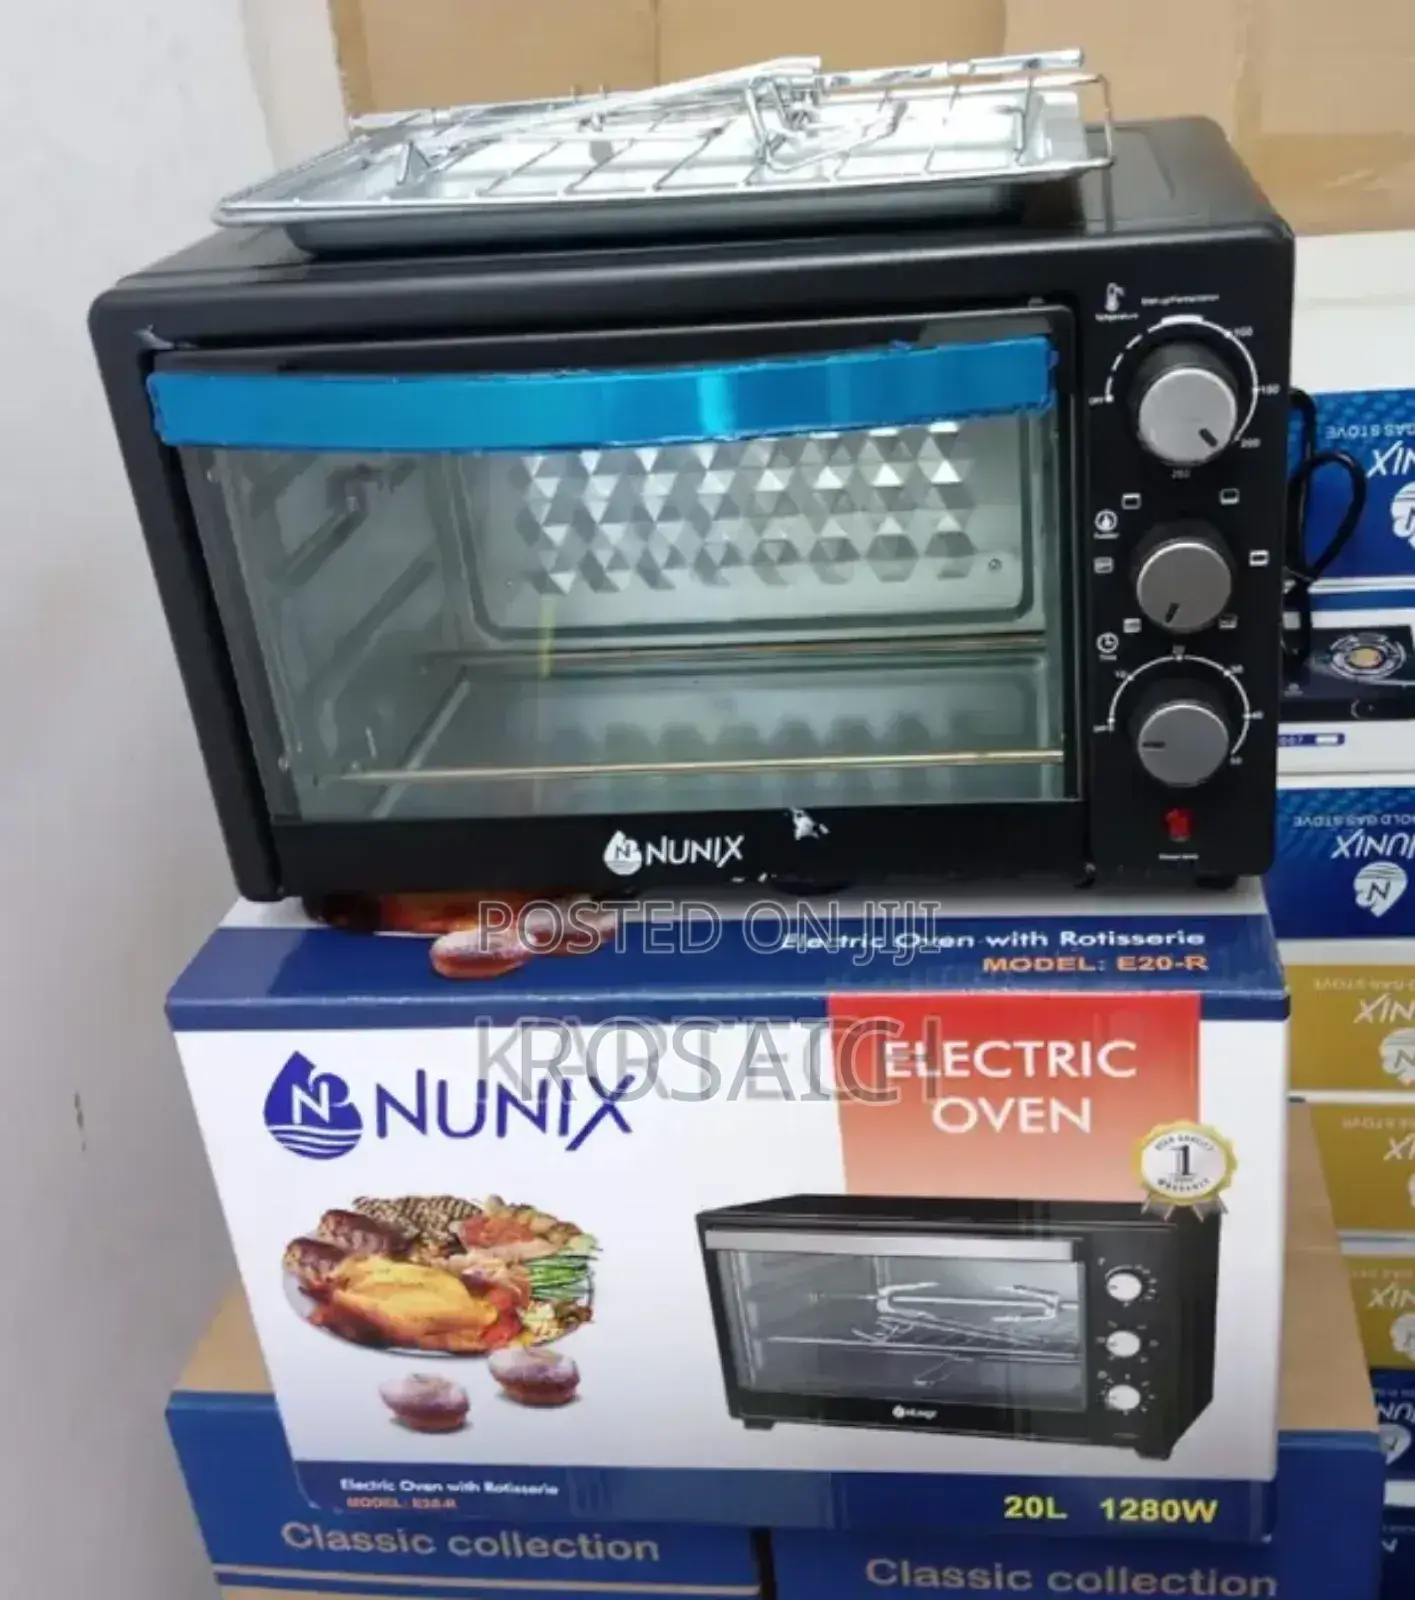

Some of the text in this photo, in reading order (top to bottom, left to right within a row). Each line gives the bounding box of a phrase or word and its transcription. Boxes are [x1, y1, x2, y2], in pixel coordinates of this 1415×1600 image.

[1325, 424, 1381, 440] STOVE
[1380, 813, 1415, 825] OLD
[645, 834, 744, 868] NUNIX
[782, 929, 1206, 949] Electric Oven with Rotisserie
[983, 955, 1210, 973] MODEL: E20-R
[885, 1039, 1138, 1079] ELECTRIC
[375, 1067, 636, 1152] NUNIX
[932, 1096, 1092, 1135] OVEN
[340, 1478, 559, 1496] Electric Oven with Rotisserie
[1003, 1495, 1219, 1524] 20L 1280W
[281, 1521, 660, 1562] Classic collection
[866, 1557, 1278, 1598] Classic collection
